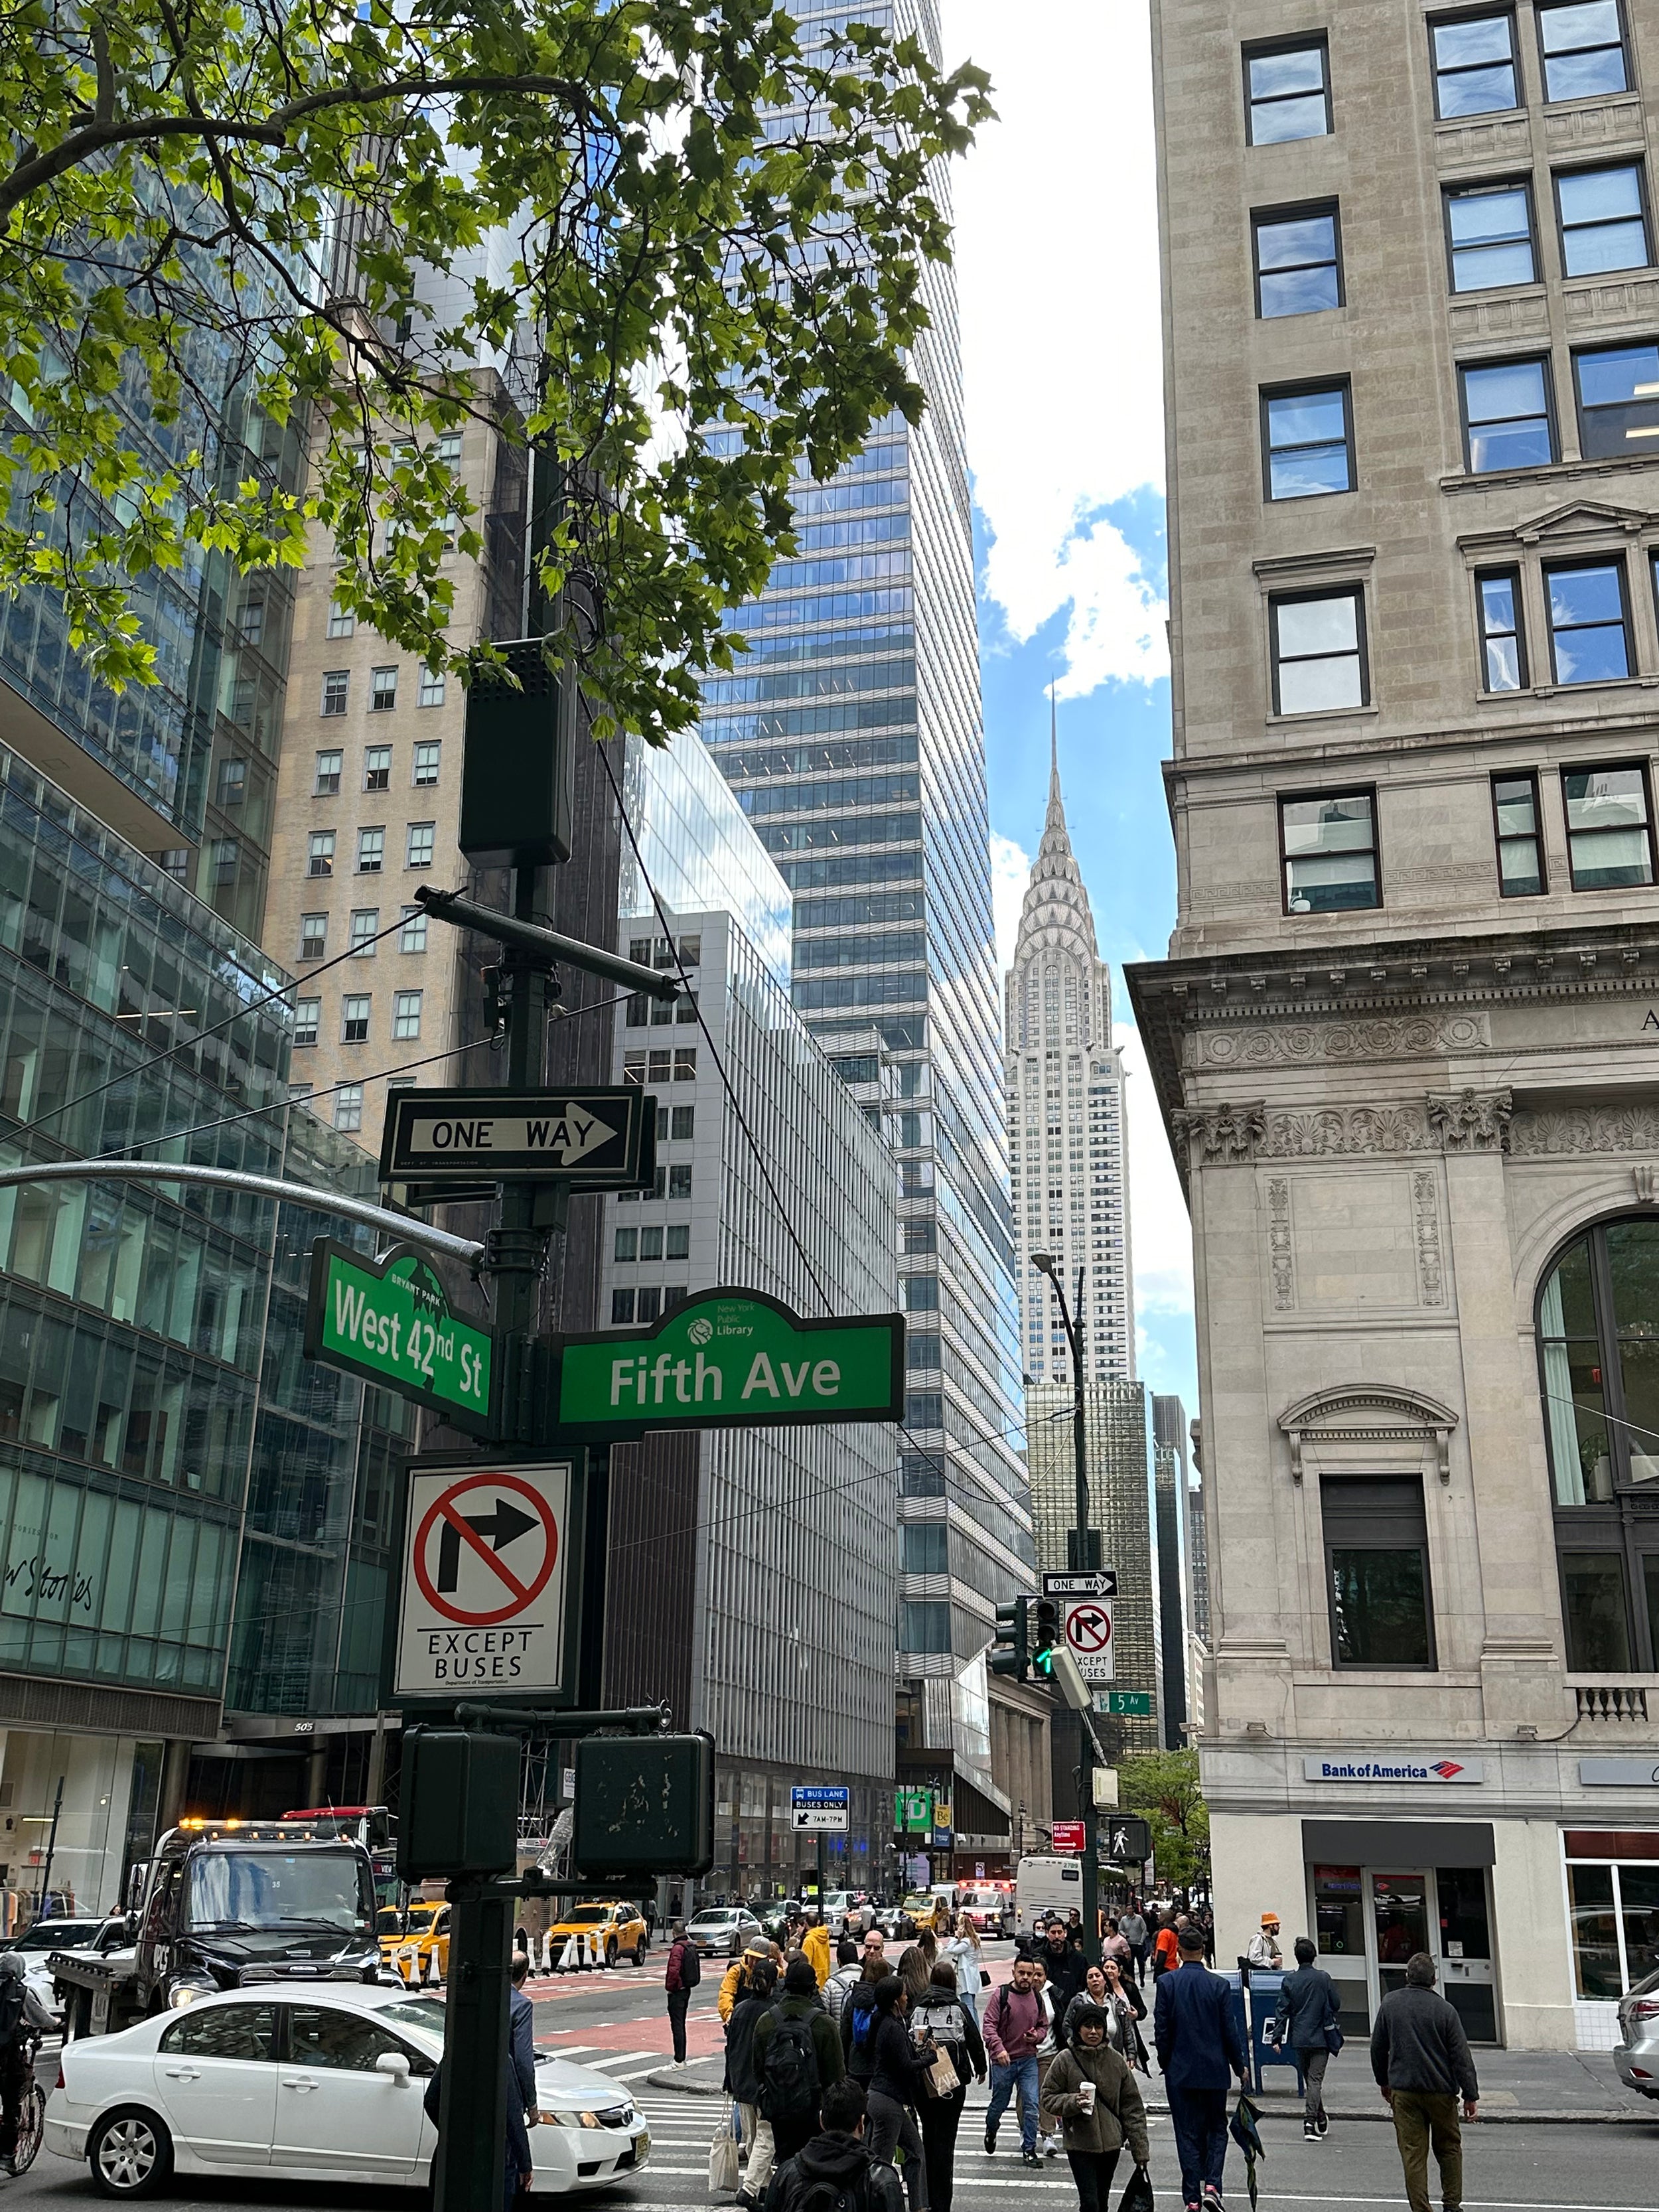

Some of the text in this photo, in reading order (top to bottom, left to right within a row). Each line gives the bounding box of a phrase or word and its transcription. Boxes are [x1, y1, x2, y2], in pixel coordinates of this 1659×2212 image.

[432, 1120, 595, 1149] ONE WAY
[392, 1273, 441, 1307] BRYANT PARK
[717, 1303, 755, 1313] New York
[717, 1315, 741, 1324] Public
[336, 1279, 482, 1398] West 42nd St
[717, 1325, 754, 1338] Library
[610, 1351, 841, 1406] Fifth Ave
[1053, 1579, 1106, 1589] ONE WAY
[429, 1631, 532, 1654] EXCEPT
[435, 1656, 521, 1678] BUSES
[1078, 1657, 1108, 1666] XCEPT
[1082, 1668, 1106, 1678] USES
[1118, 1695, 1125, 1710] 5
[294, 1722, 313, 1732] 505
[1322, 1763, 1427, 1778] Bank of America
